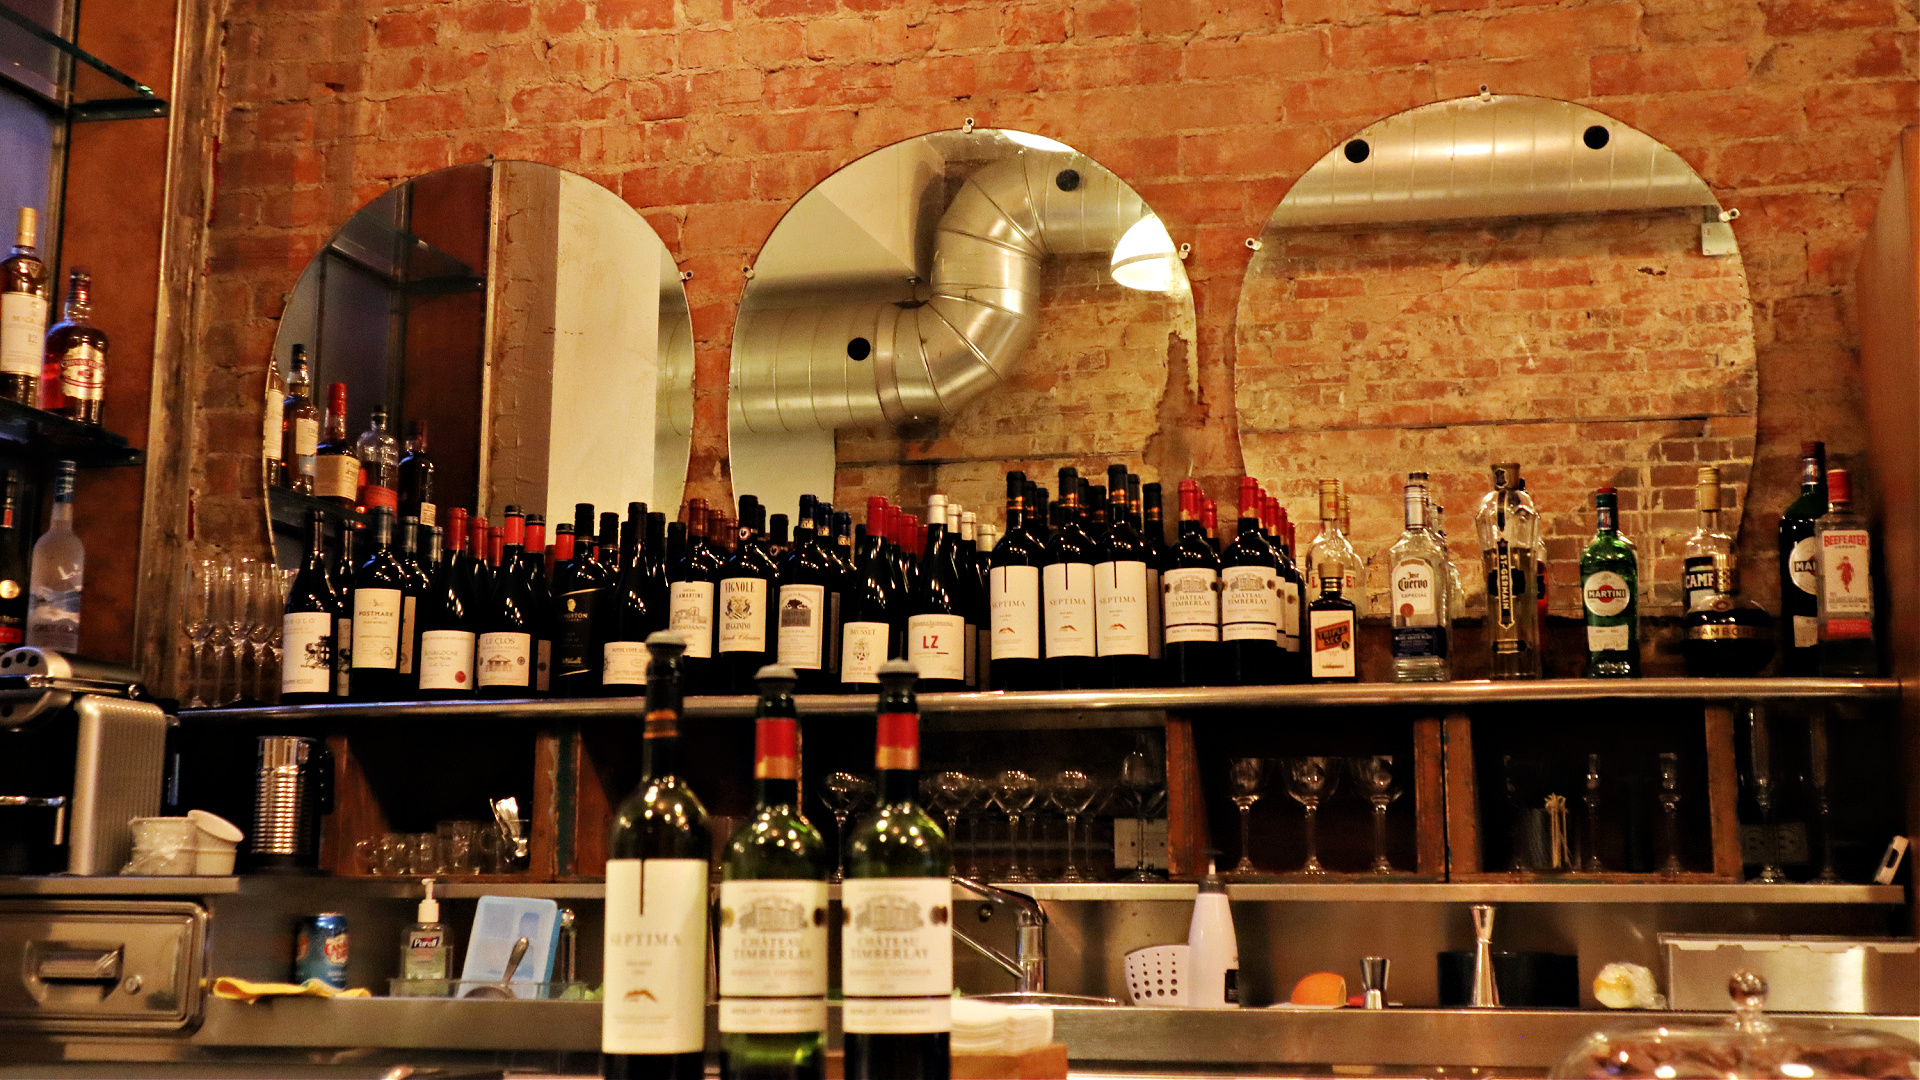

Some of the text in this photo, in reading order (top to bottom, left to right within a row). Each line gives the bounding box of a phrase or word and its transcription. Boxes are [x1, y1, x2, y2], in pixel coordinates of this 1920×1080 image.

[1824, 535, 1867, 547] BEEFEATER
[725, 581, 756, 593] VIGNOLE
[1398, 577, 1428, 591] Cuervo
[1500, 554, 1510, 610] ST-GERMAIN
[1588, 590, 1625, 598] MARTINI
[991, 599, 1026, 608] SEPTIMA
[1049, 598, 1086, 606] SEPTIMA
[1099, 596, 1136, 605] SEPTIMA
[1317, 625, 1347, 640] TRIPLE
[922, 635, 939, 649] LZ
[732, 949, 812, 961] TIMBERLAY
[850, 948, 929, 961] TIMBERLAY
